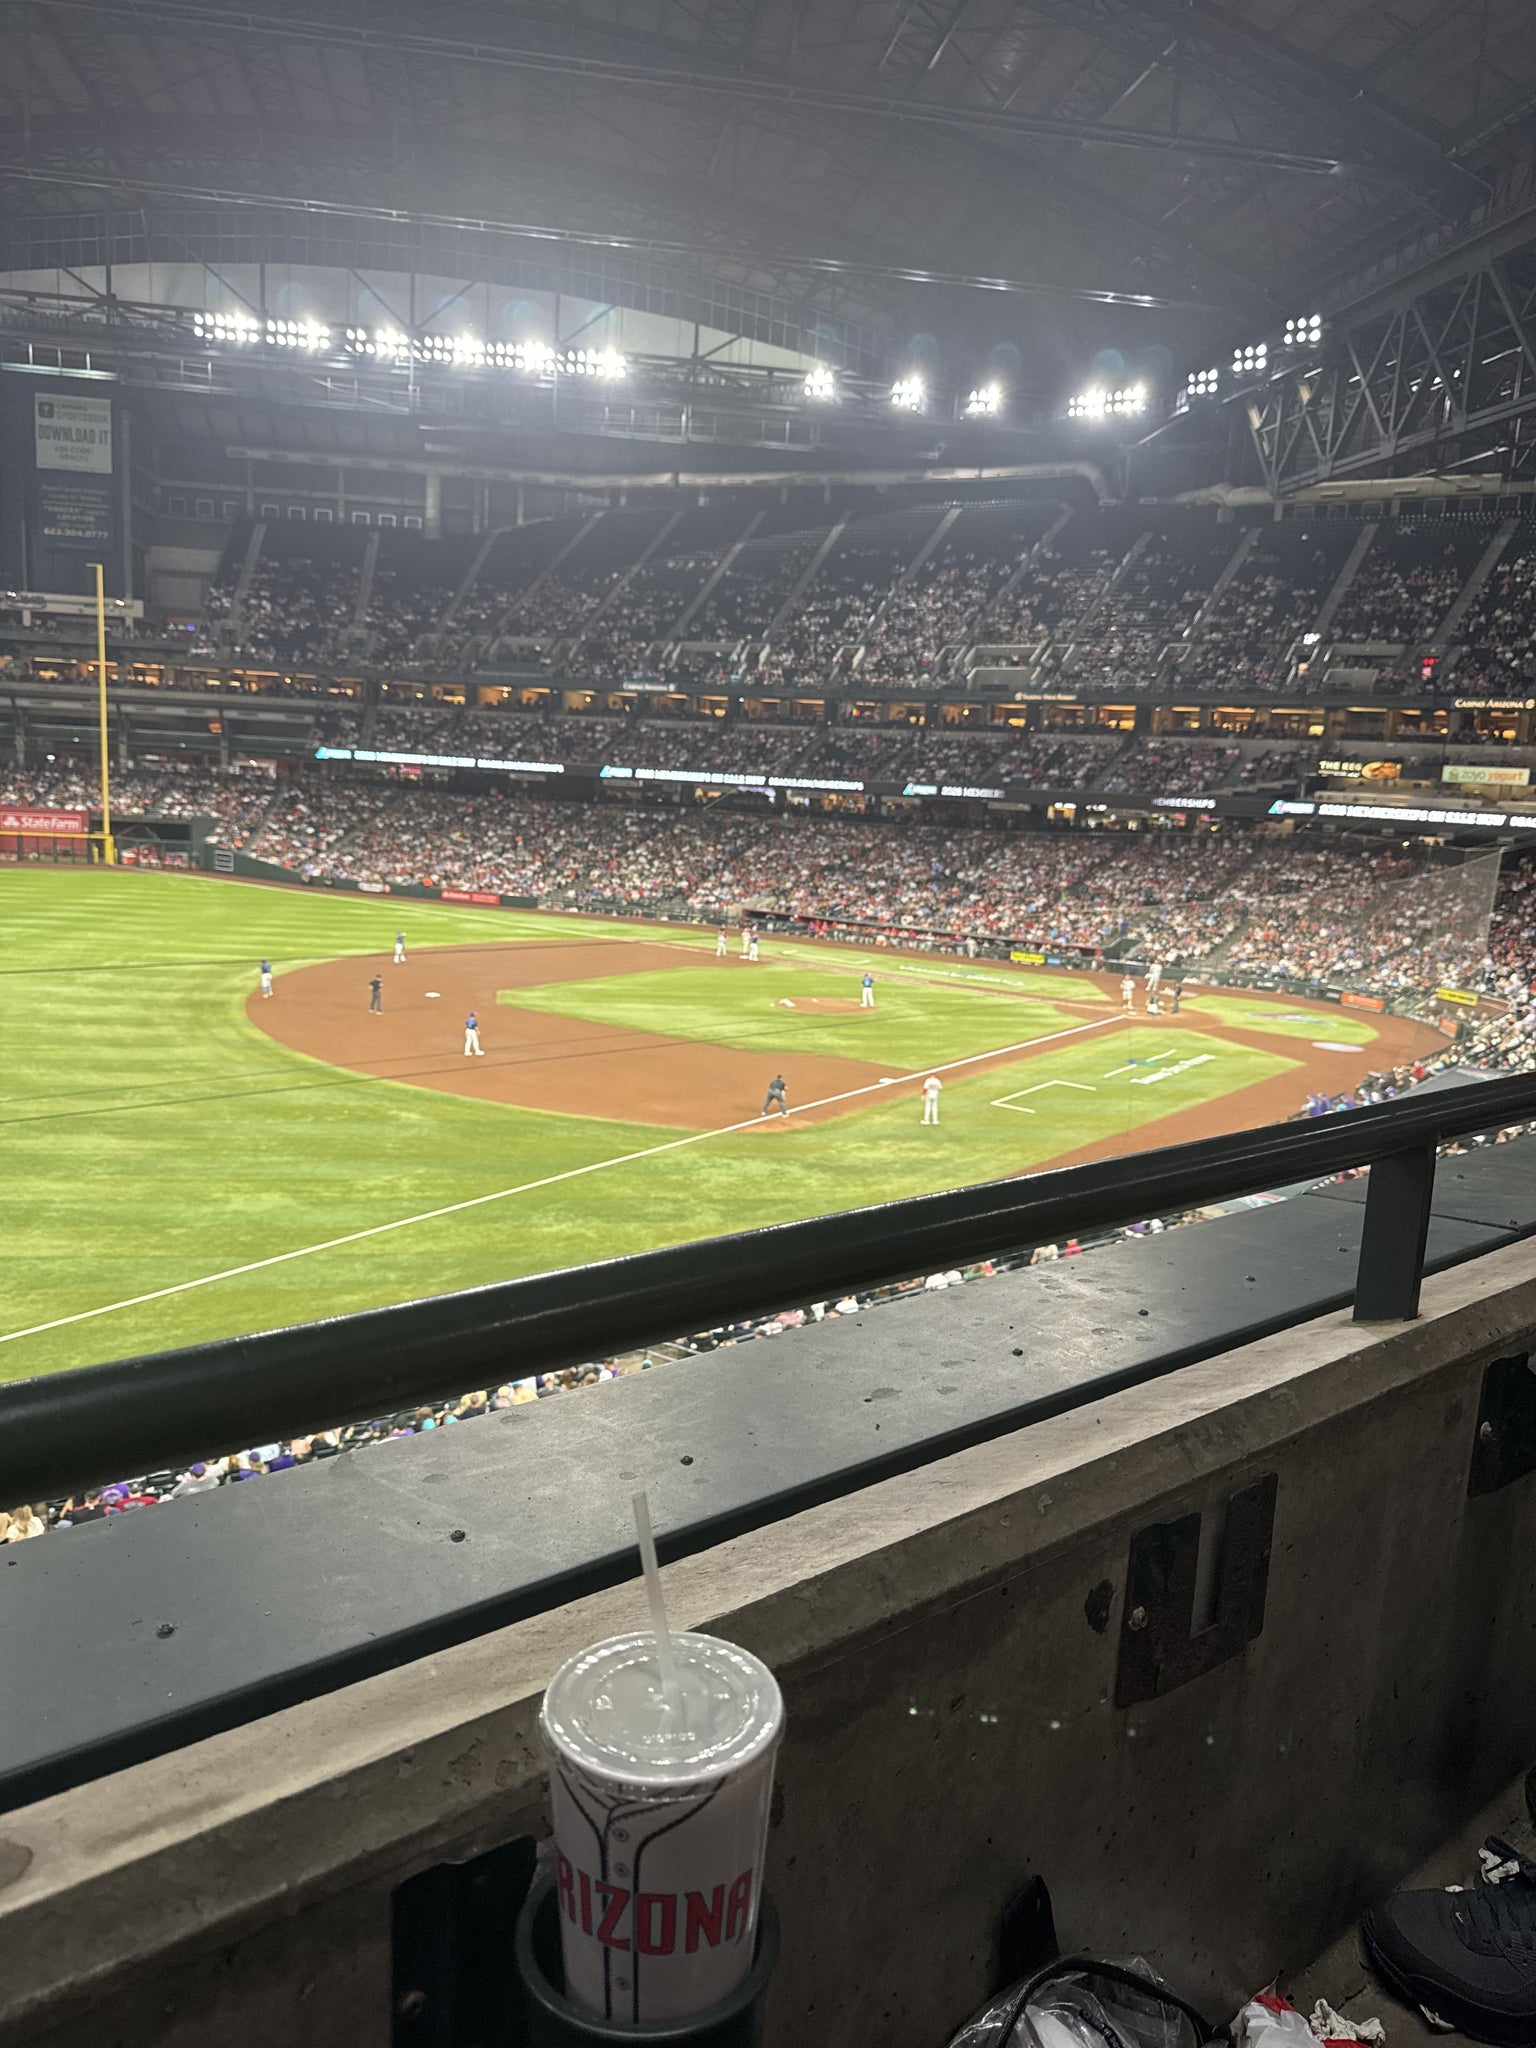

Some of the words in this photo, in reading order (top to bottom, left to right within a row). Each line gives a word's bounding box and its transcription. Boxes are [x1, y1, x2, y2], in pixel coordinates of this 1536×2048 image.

[38, 424, 96, 444] DOWNLOAD
[98, 430, 109, 446] IT
[1454, 698, 1486, 709] CASINO
[1486, 698, 1524, 710] ARIZONA
[1318, 760, 1341, 771] THE
[1487, 769, 1523, 783] yogurt
[556, 1847, 753, 1956] RIZONA
